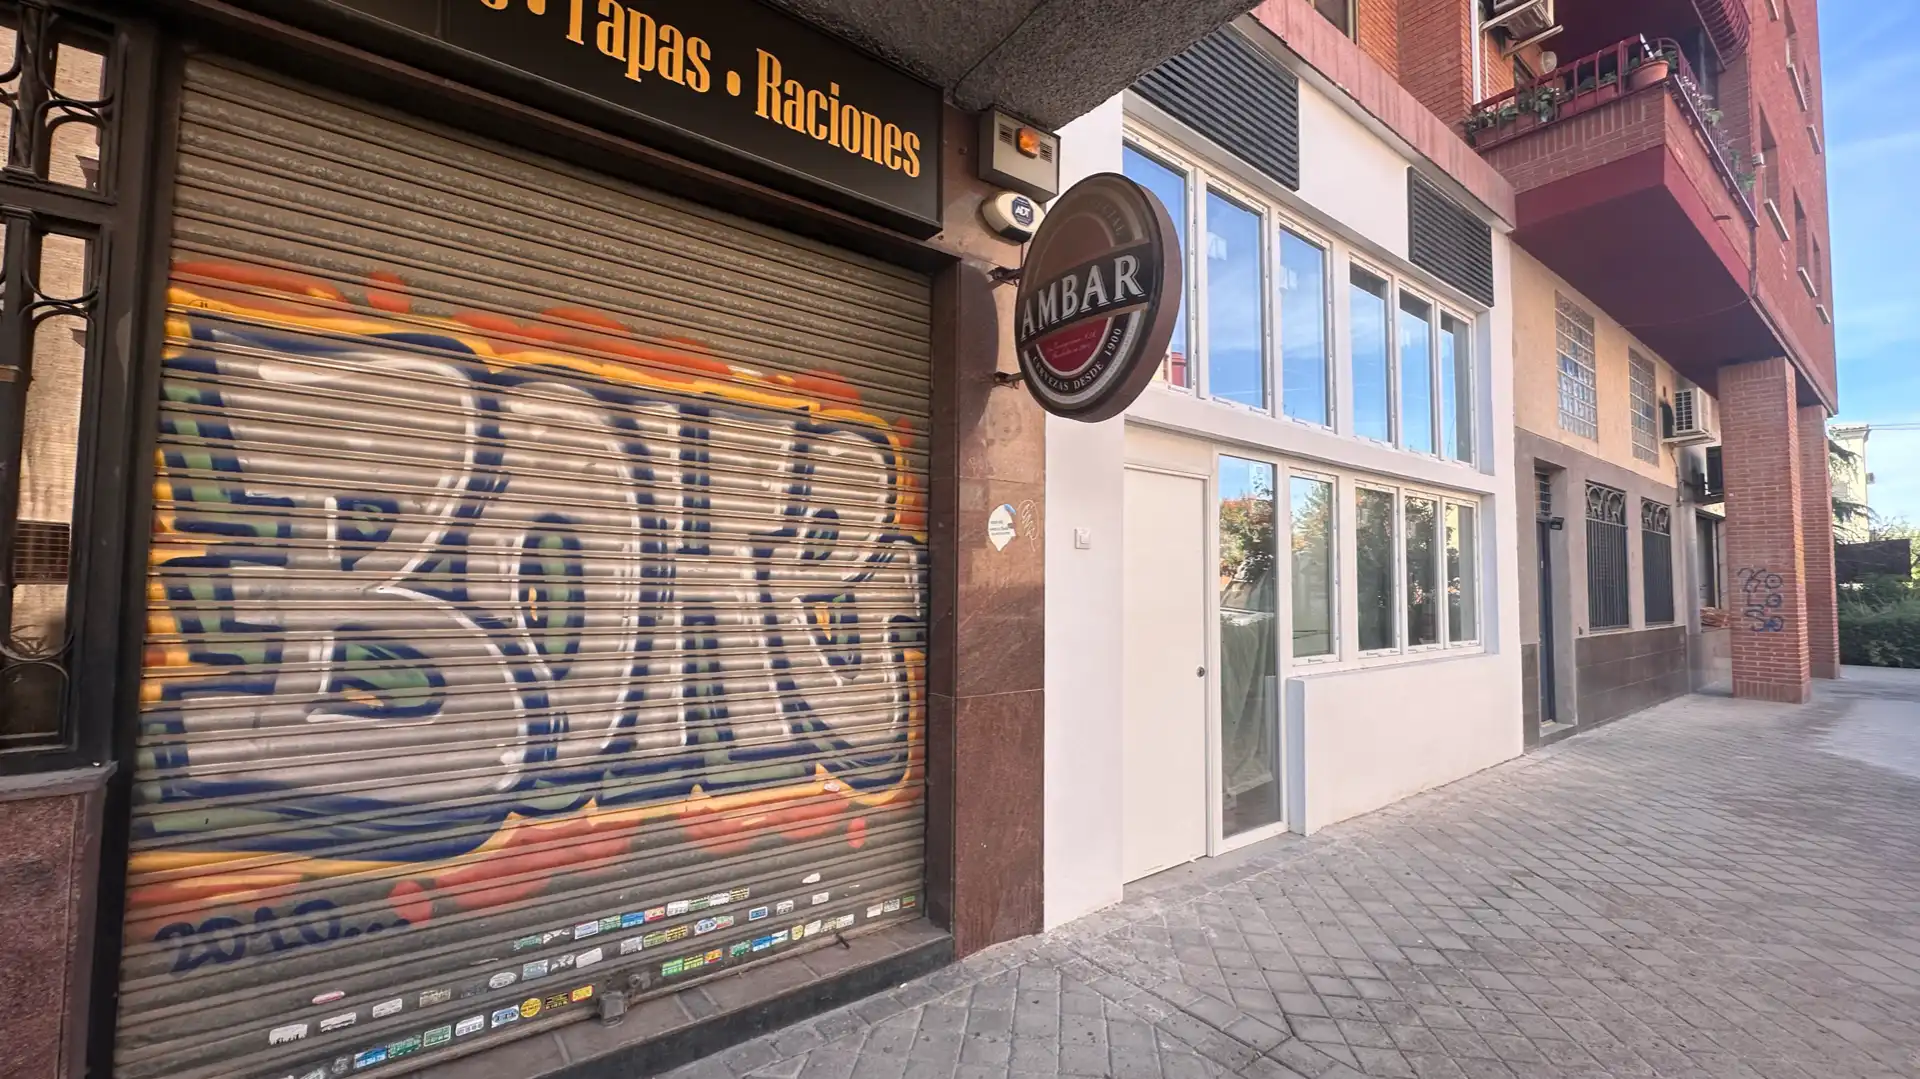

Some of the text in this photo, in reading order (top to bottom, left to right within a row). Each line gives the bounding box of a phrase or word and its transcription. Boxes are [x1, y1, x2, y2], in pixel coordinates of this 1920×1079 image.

[755, 48, 921, 178] Raciones
[1014, 205, 1031, 218] ADT
[1020, 254, 1146, 342] AMBAR
[1073, 361, 1104, 390] DESDE
[1104, 327, 1123, 357] 1900
